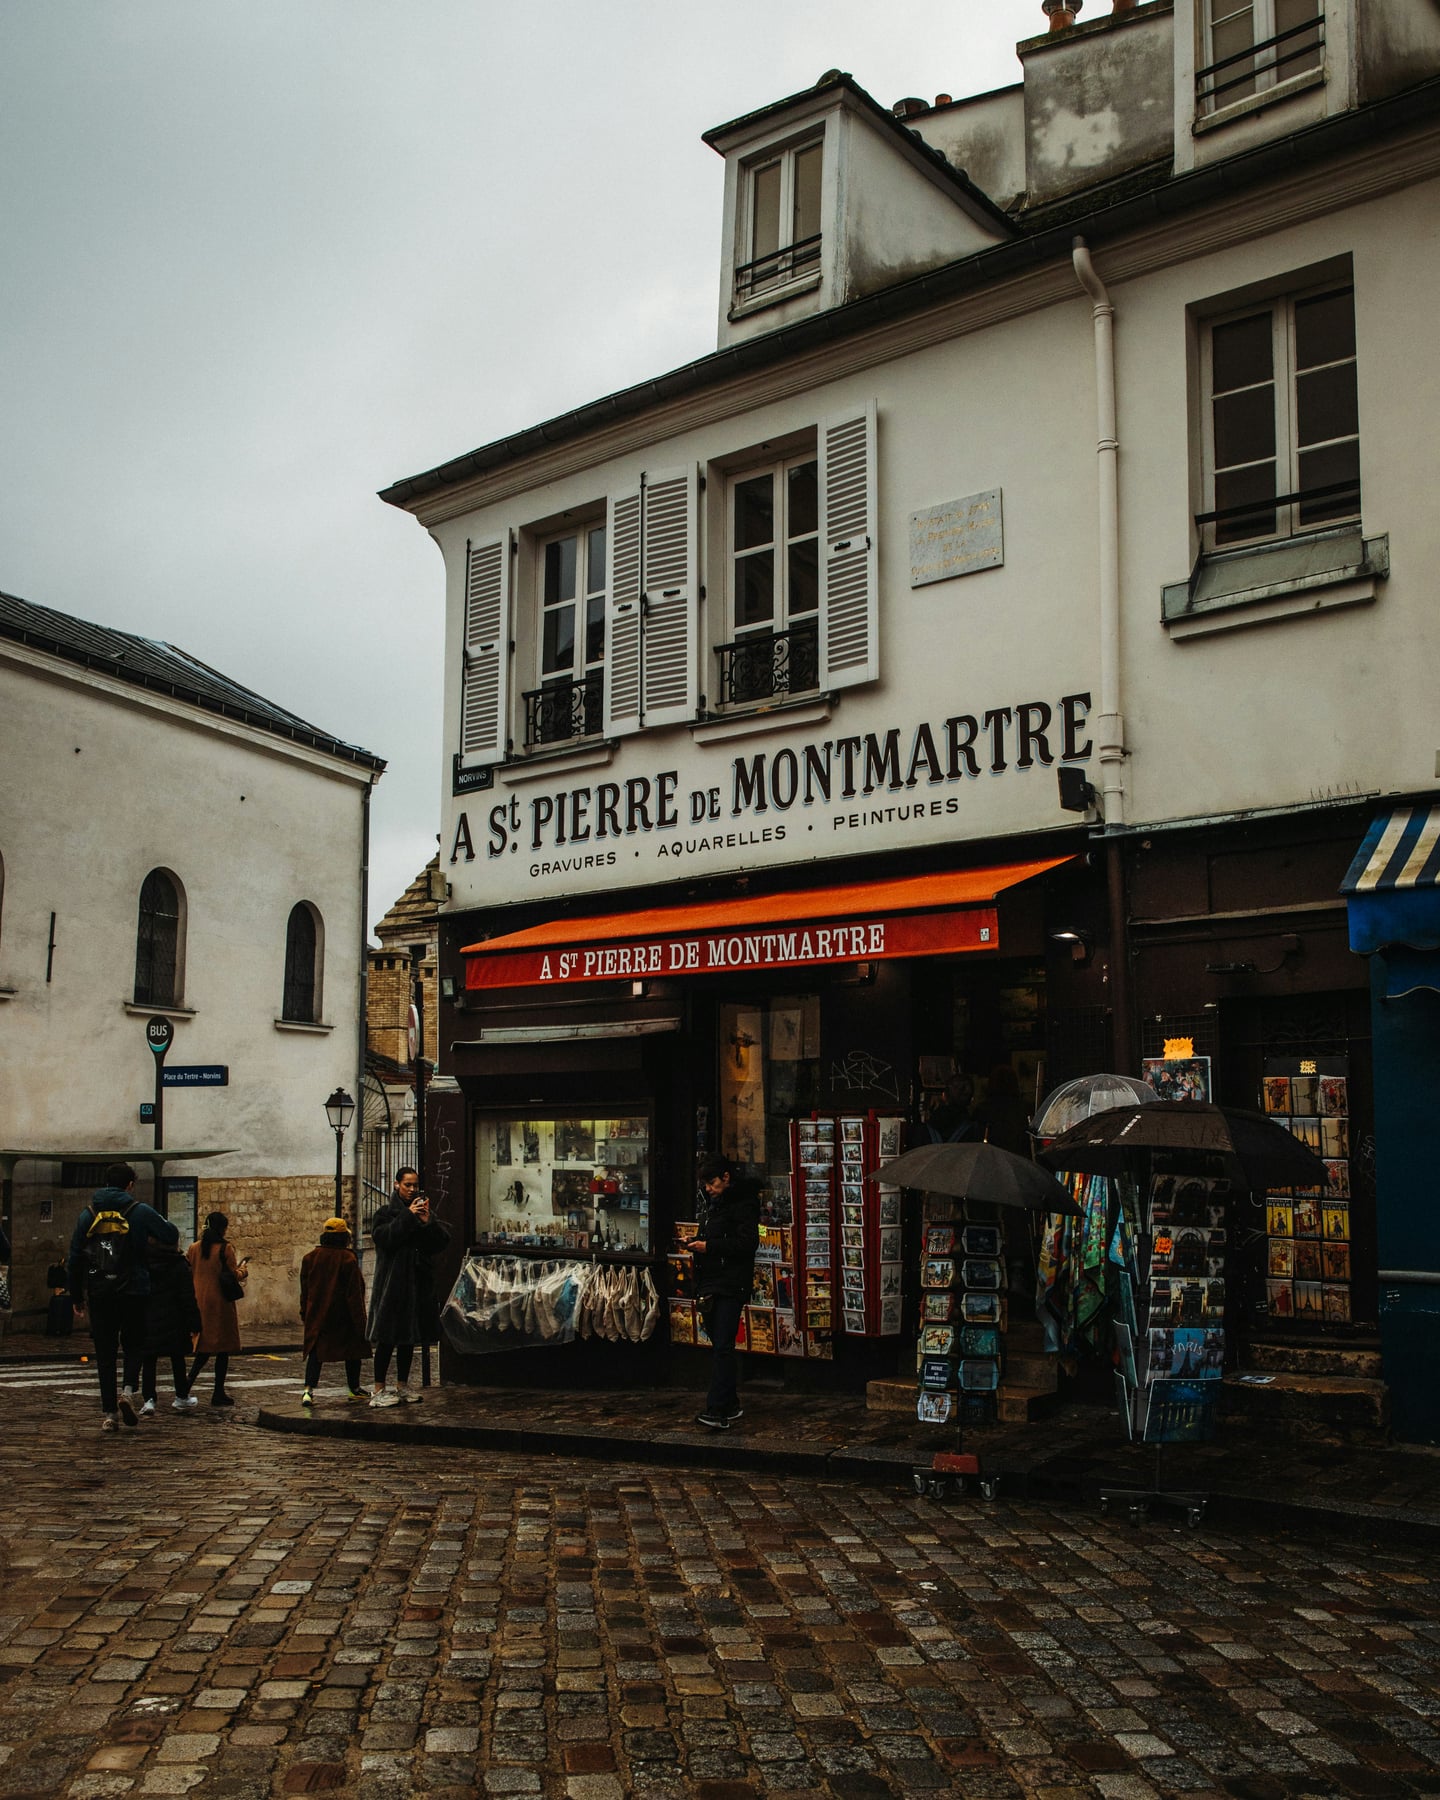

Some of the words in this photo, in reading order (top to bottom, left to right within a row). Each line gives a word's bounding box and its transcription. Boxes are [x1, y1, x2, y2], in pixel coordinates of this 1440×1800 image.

[450, 813, 475, 863] A
[531, 771, 679, 850] PIERRE
[690, 787, 721, 824] DE
[731, 692, 1094, 817] MONTMARTRE
[529, 851, 617, 878] GRAVURES
[657, 825, 786, 858] AQUARELLES
[833, 798, 959, 830] PEINTURES
[539, 955, 553, 980] A
[583, 945, 662, 977] PIERRE
[669, 941, 700, 970] DE
[707, 923, 885, 967] MONTMARTRE
[150, 1025, 168, 1037] BUS
[1170, 1341, 1203, 1355] PARIS
